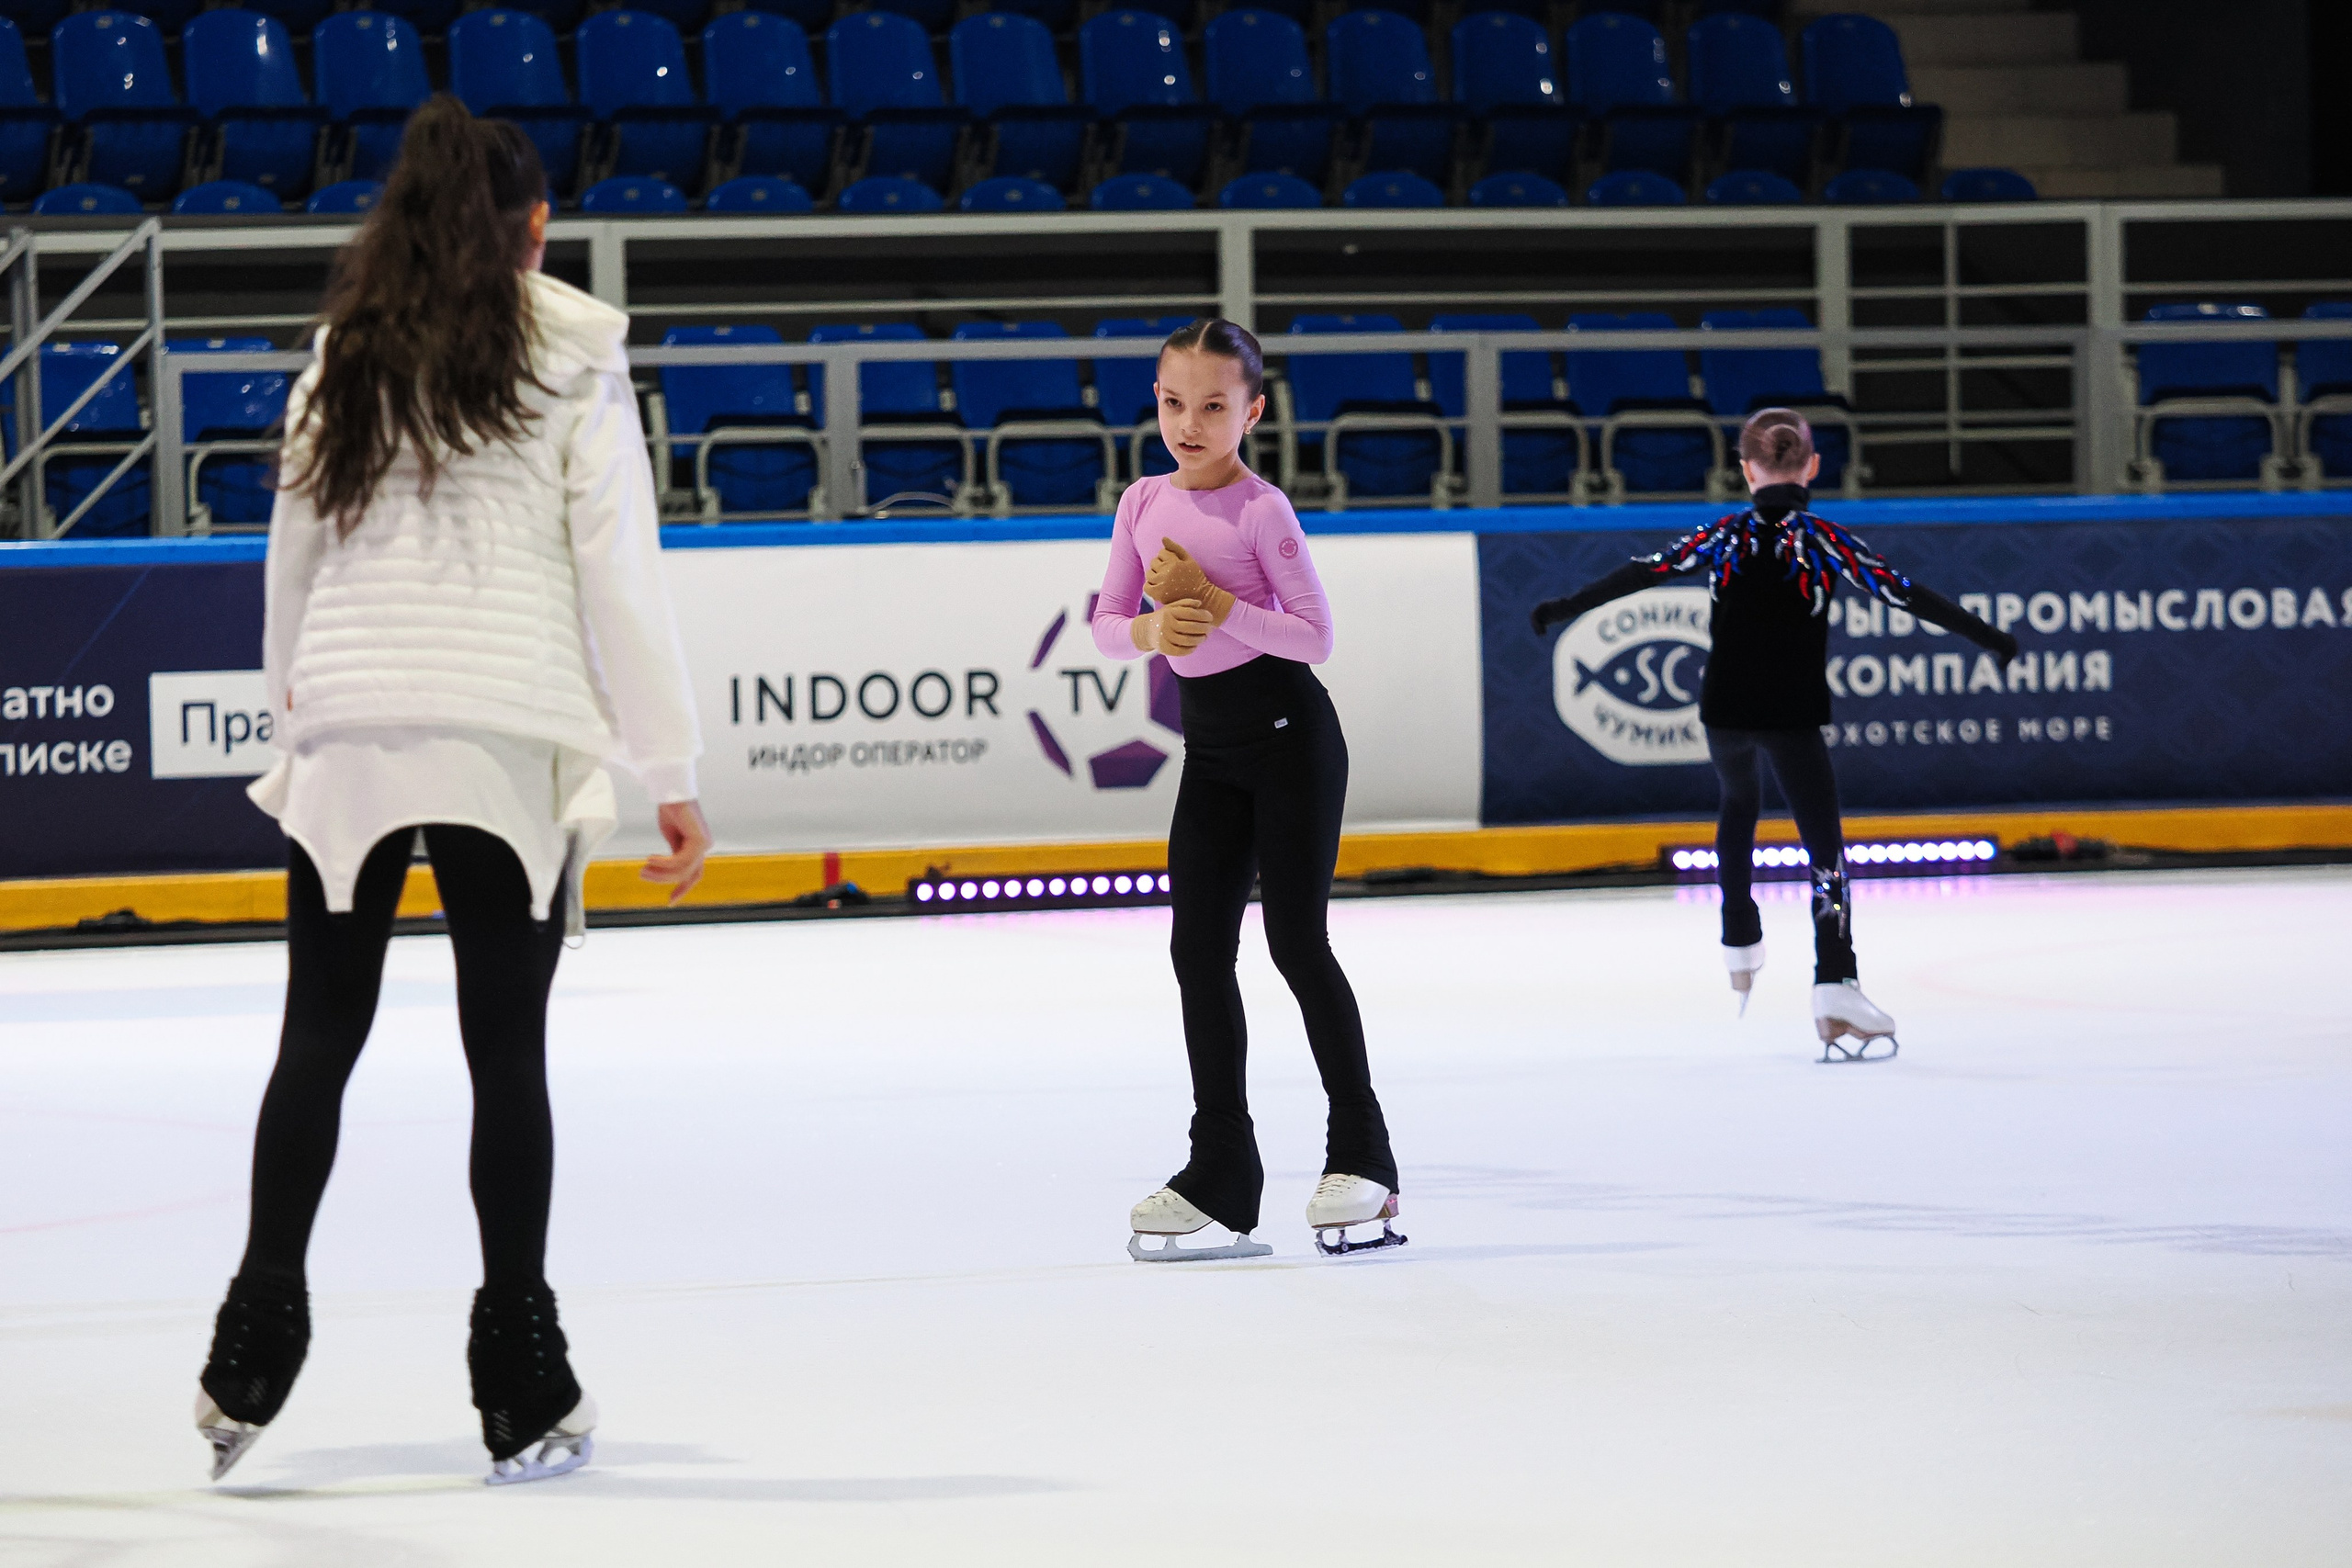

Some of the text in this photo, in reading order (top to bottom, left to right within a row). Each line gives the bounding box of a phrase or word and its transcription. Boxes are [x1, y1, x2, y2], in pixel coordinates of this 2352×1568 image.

[1059, 669, 1129, 714] TV
[1636, 646, 1705, 704] SC
[2, 684, 115, 720] атно
[729, 671, 1001, 723] INDOOR
[2018, 716, 2110, 742] МОРЕ
[748, 739, 989, 775] ИНДОР ОПЕРАТОР
